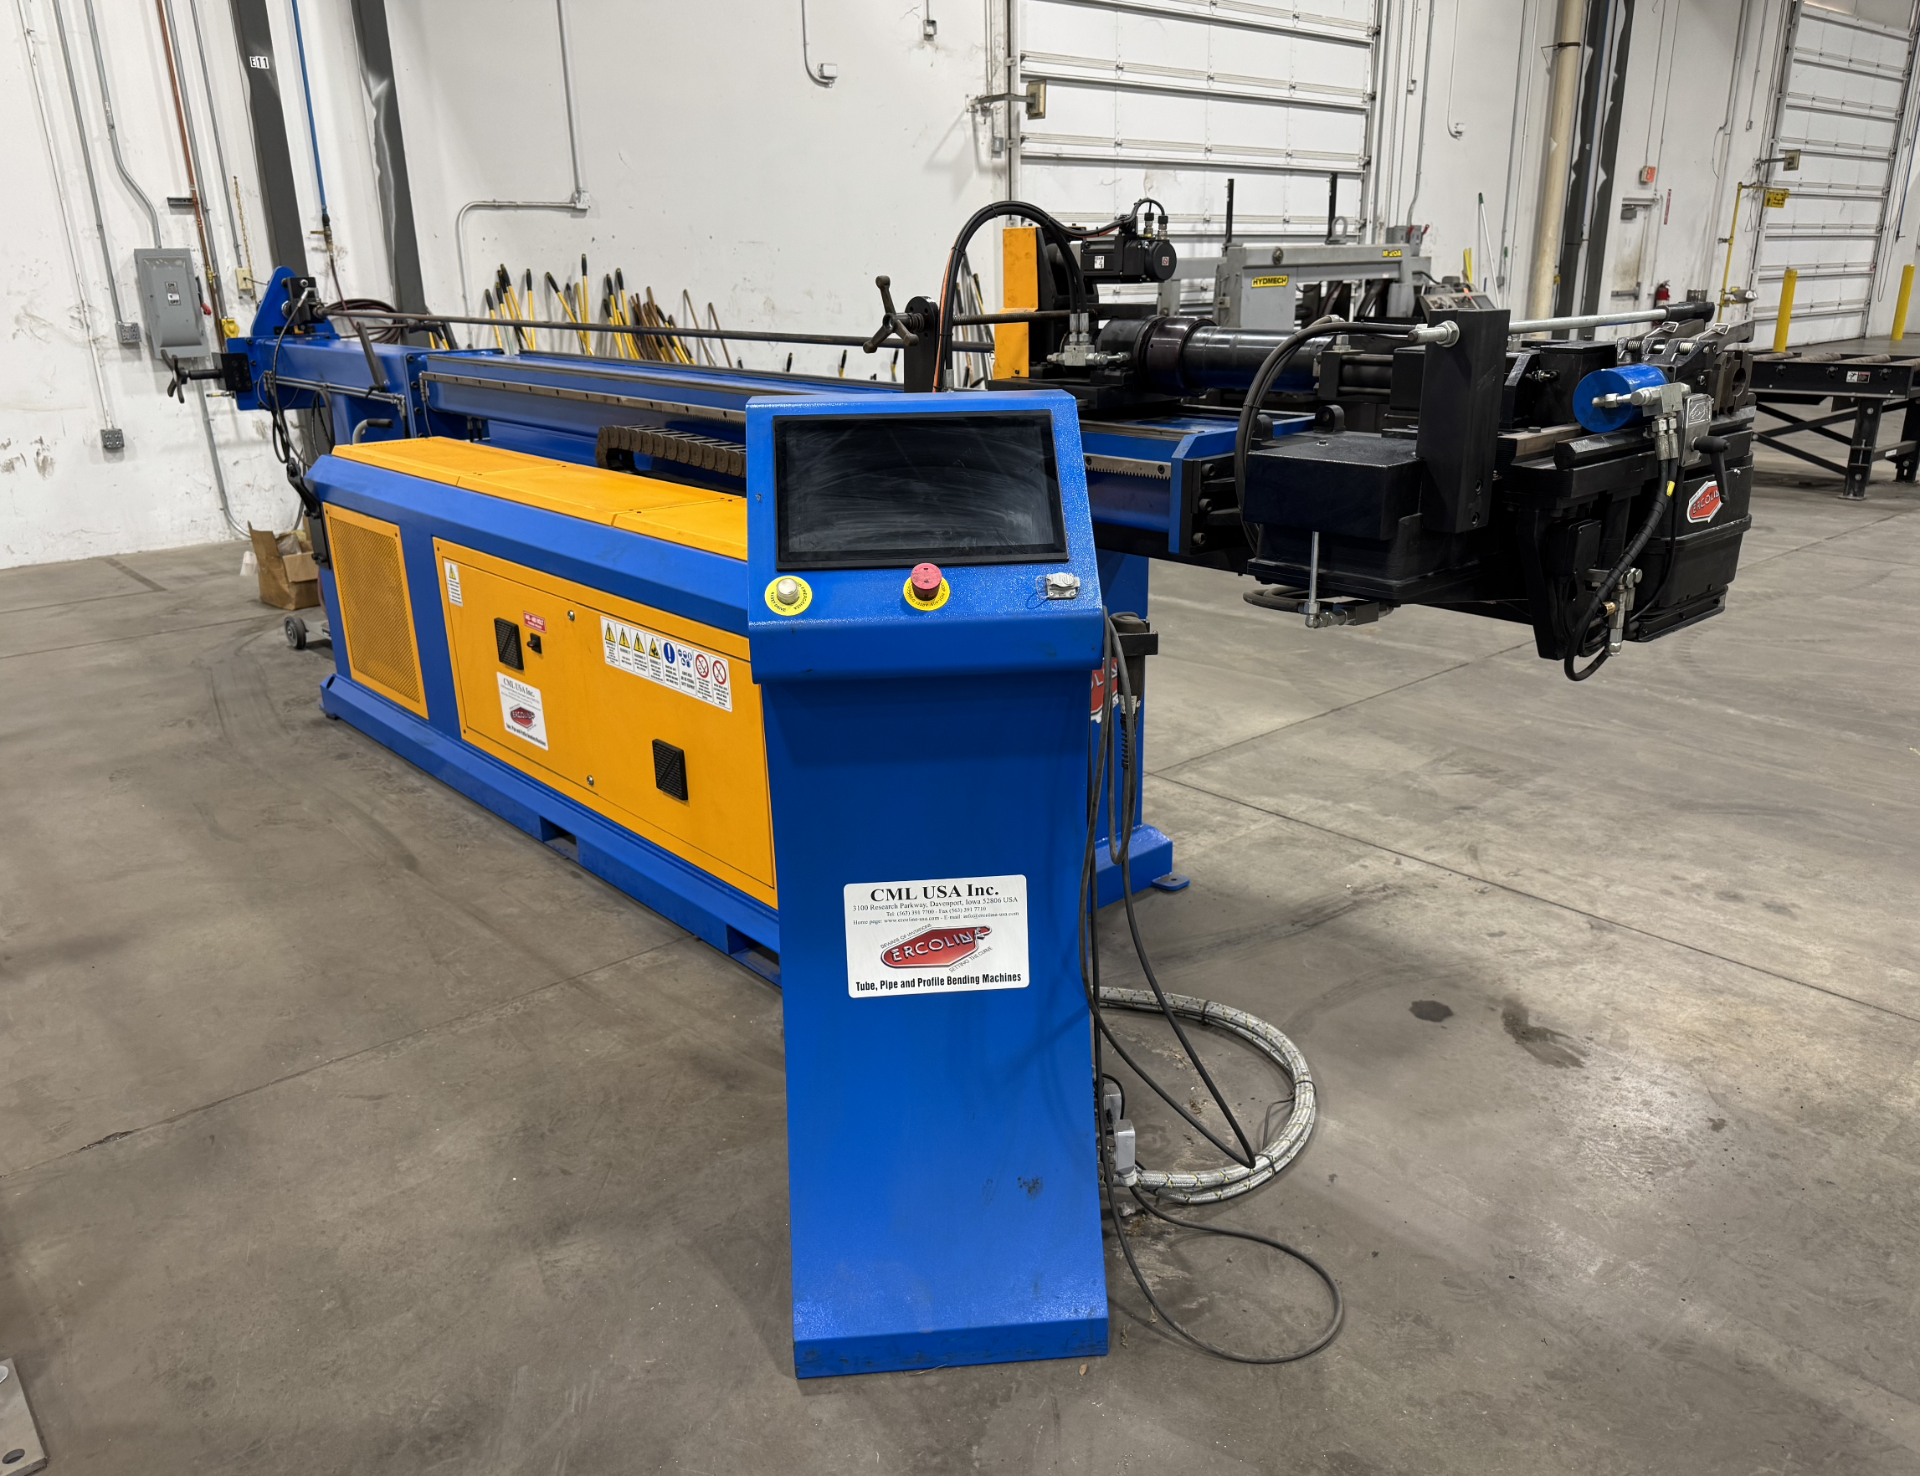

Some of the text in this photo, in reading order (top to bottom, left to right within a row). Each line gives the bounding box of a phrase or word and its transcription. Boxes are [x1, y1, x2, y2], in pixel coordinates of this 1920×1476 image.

[250, 57, 268, 68] E11
[1253, 277, 1287, 286] HYDMECH
[1692, 489, 1720, 515] ERCOLIN
[870, 883, 999, 902] CML USA Inc.
[852, 904, 869, 912] 3100
[870, 902, 898, 911] Research
[899, 901, 928, 910] Parkway,
[929, 899, 964, 908] Davenport,
[890, 928, 986, 962] ERCOLINA
[948, 959, 970, 973] SETTING
[978, 945, 993, 957] CURVE
[855, 972, 1022, 992] Tube, Pipe and Profile Bending Machines
